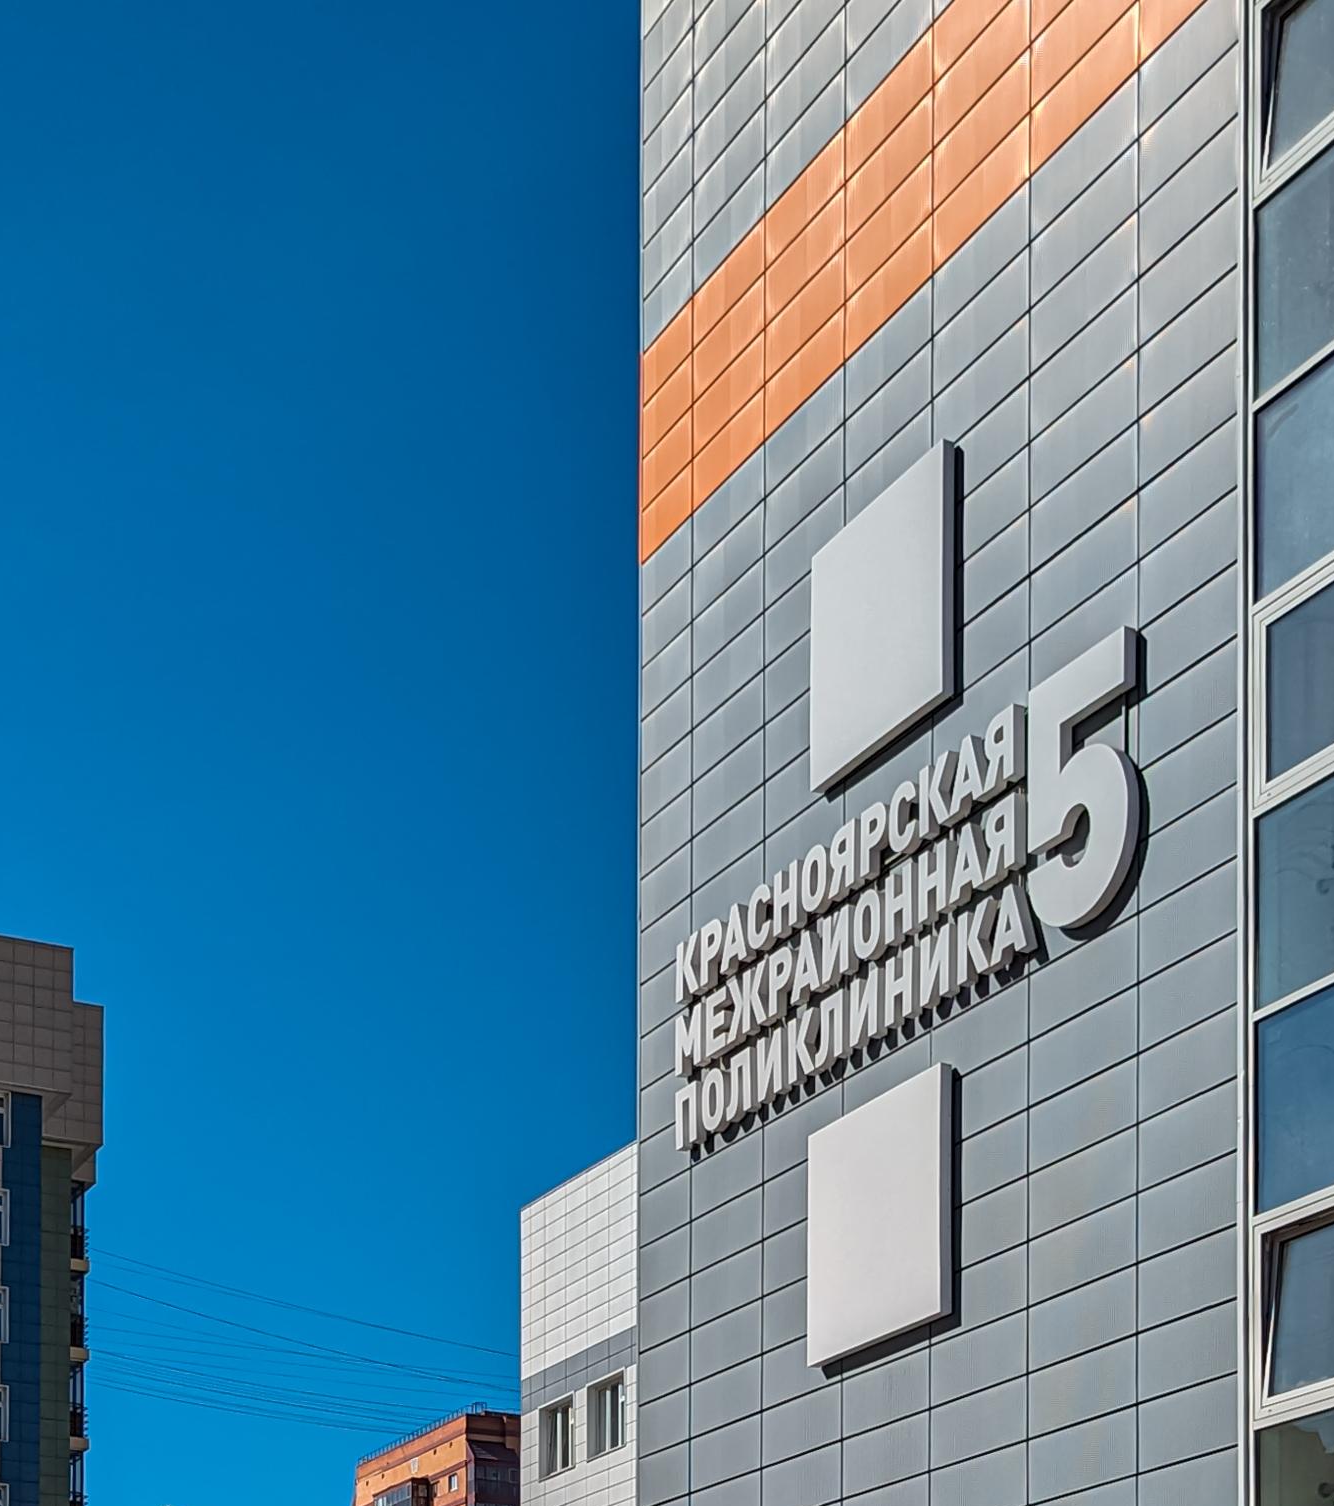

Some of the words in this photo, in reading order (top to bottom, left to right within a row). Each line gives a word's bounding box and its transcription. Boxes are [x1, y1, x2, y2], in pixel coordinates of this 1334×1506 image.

[675, 703, 1026, 1004] КРАСНОЯРСКАЯ
[1027, 626, 1141, 928] 5
[675, 793, 1026, 1077] МЕЖРАЙОННАЯ
[675, 884, 1038, 1151] ПОЛИКЛИНИКА
